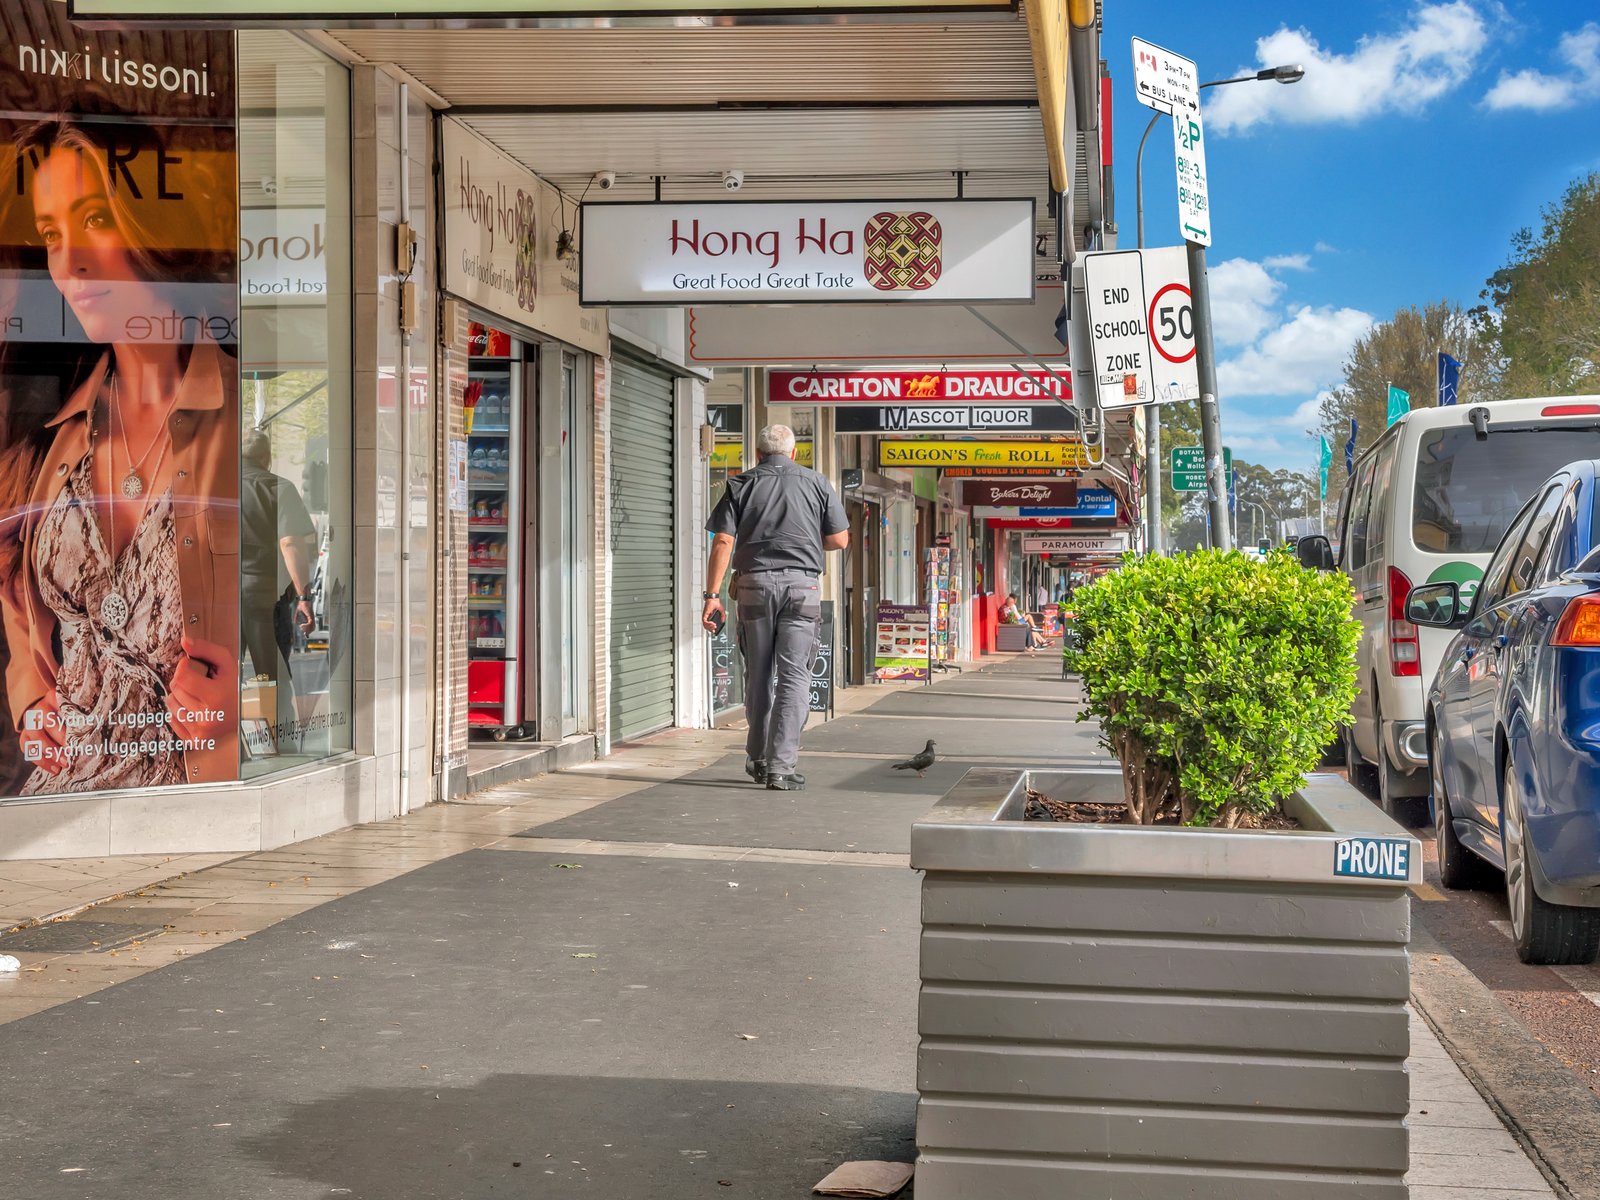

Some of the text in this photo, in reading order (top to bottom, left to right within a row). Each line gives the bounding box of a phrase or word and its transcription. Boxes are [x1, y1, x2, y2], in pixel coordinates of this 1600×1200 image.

[1152, 85, 1187, 107] BUS LANE
[460, 155, 514, 253] Hong Ha
[668, 218, 854, 269] Hong Ha
[673, 272, 854, 289] Great Food Great Taste
[1103, 288, 1130, 305] END
[1094, 319, 1146, 340] SCHOOL
[1160, 305, 1194, 342] 50
[1107, 353, 1142, 372] ZONE
[788, 376, 1066, 398] CARLTON DRAUGHT
[883, 405, 1030, 430] MASCOT LIQUOR
[886, 448, 1055, 463] SAIGON'S Fresh ROLL
[990, 487, 1052, 502] Bakers Delight
[1084, 494, 1112, 502] Dental
[1041, 541, 1105, 549] PARAMOUNT
[46, 711, 103, 733] Sydney
[108, 709, 172, 730] Luggage
[176, 706, 225, 722] Centre
[45, 737, 216, 759] sydneyluggagecentre
[1337, 841, 1408, 876] PRONE
